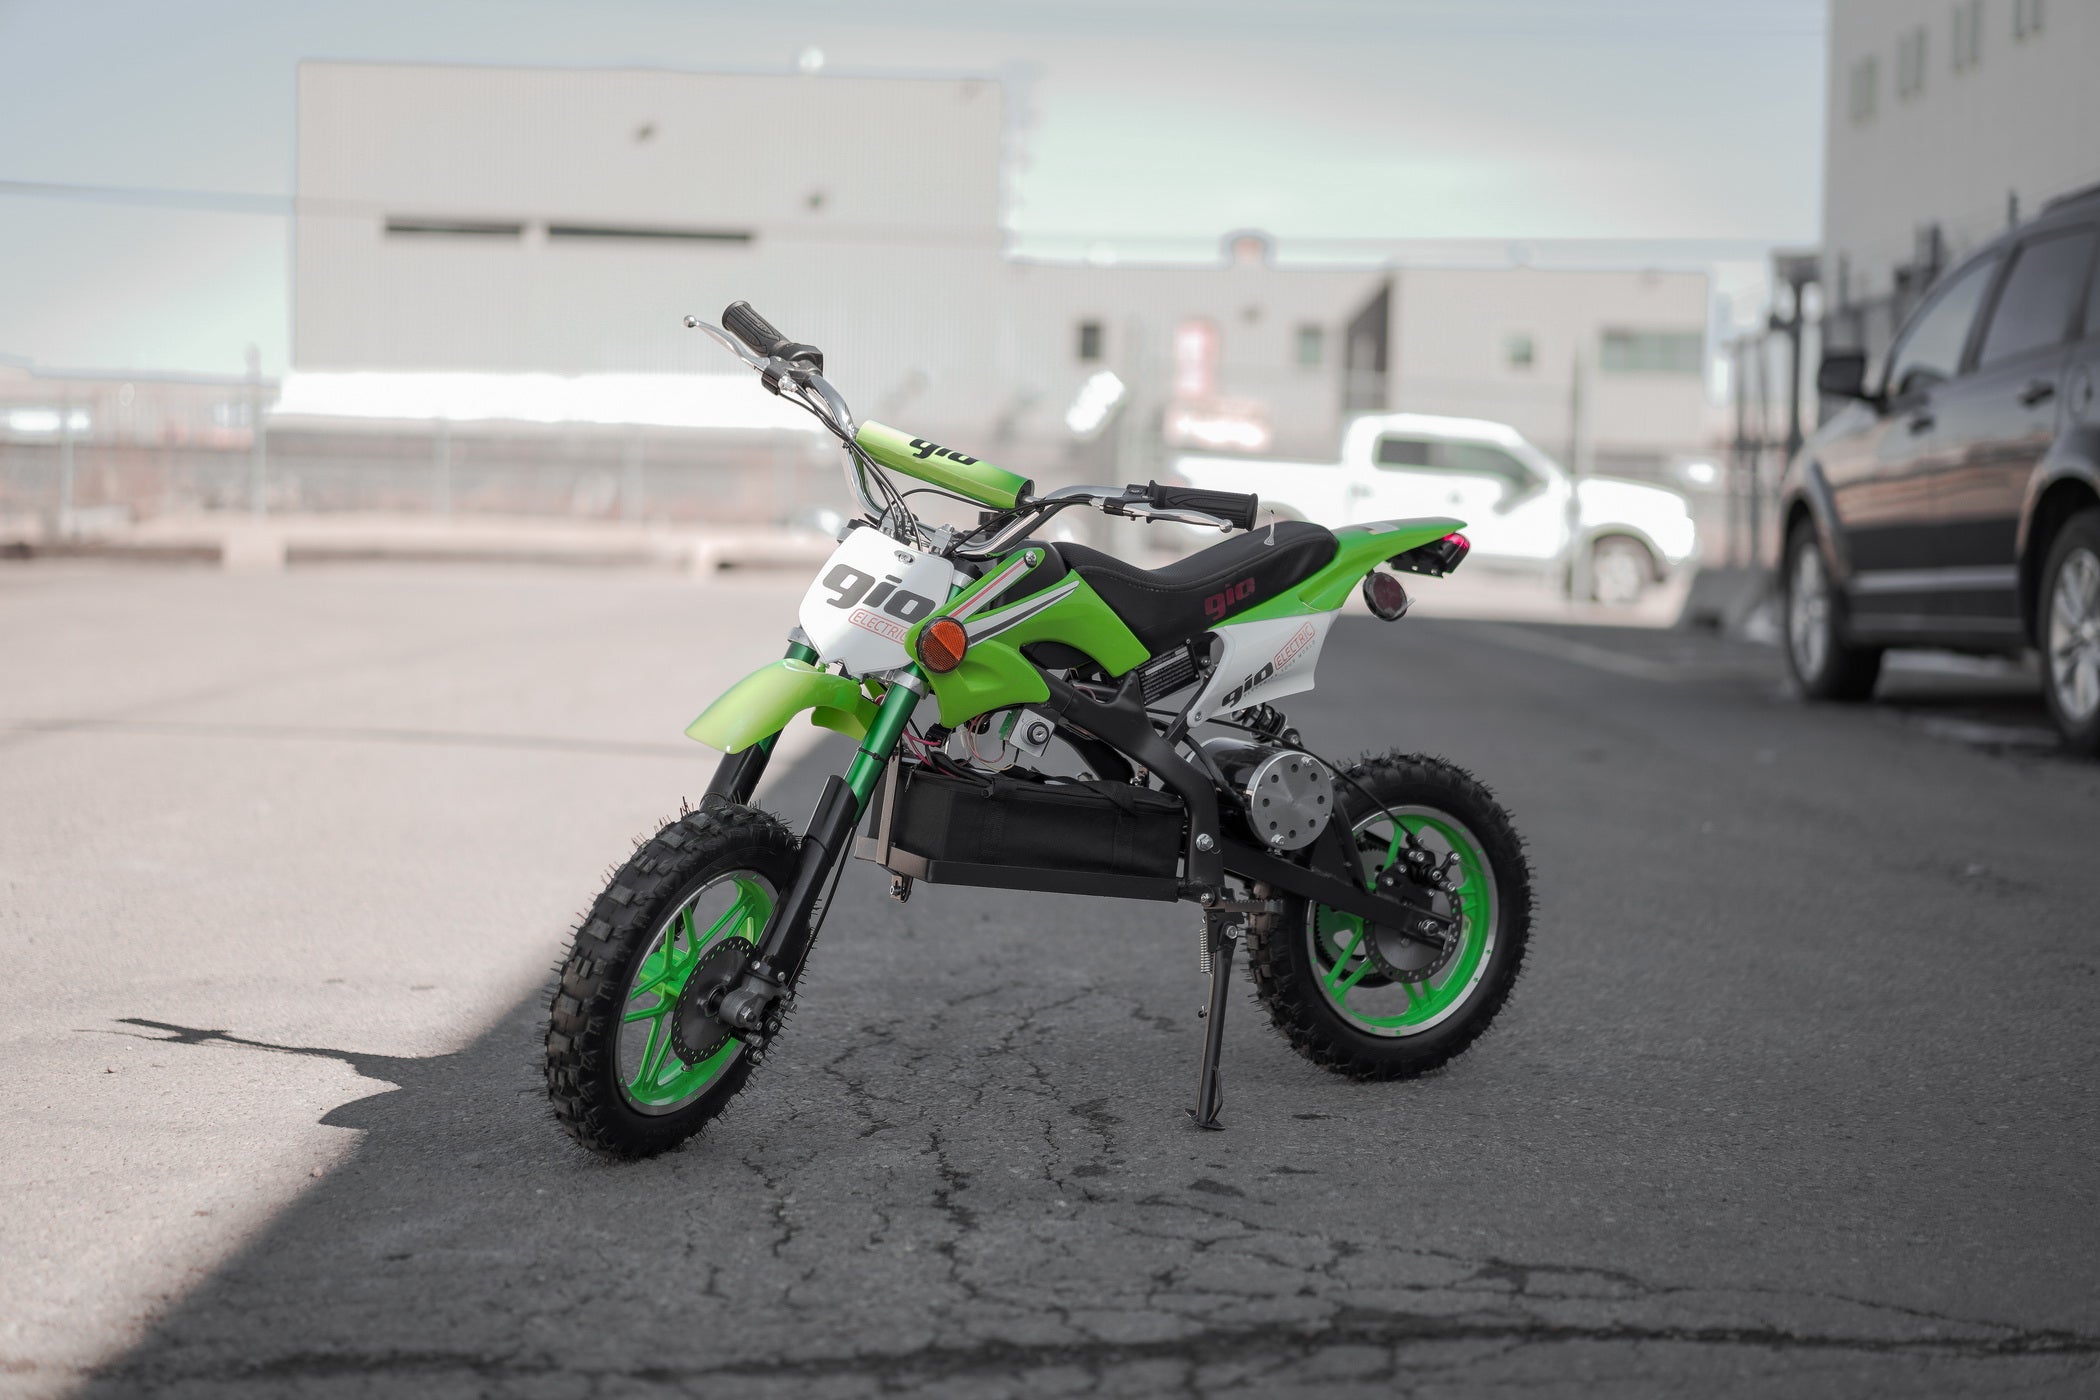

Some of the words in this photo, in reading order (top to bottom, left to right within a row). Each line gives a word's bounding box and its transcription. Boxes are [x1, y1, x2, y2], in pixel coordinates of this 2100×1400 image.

[909, 438, 979, 466] gio
[822, 563, 936, 625] gio
[1204, 577, 1256, 621] gio
[1221, 661, 1274, 708] gio
[1276, 625, 1313, 667] ELECTRIC
